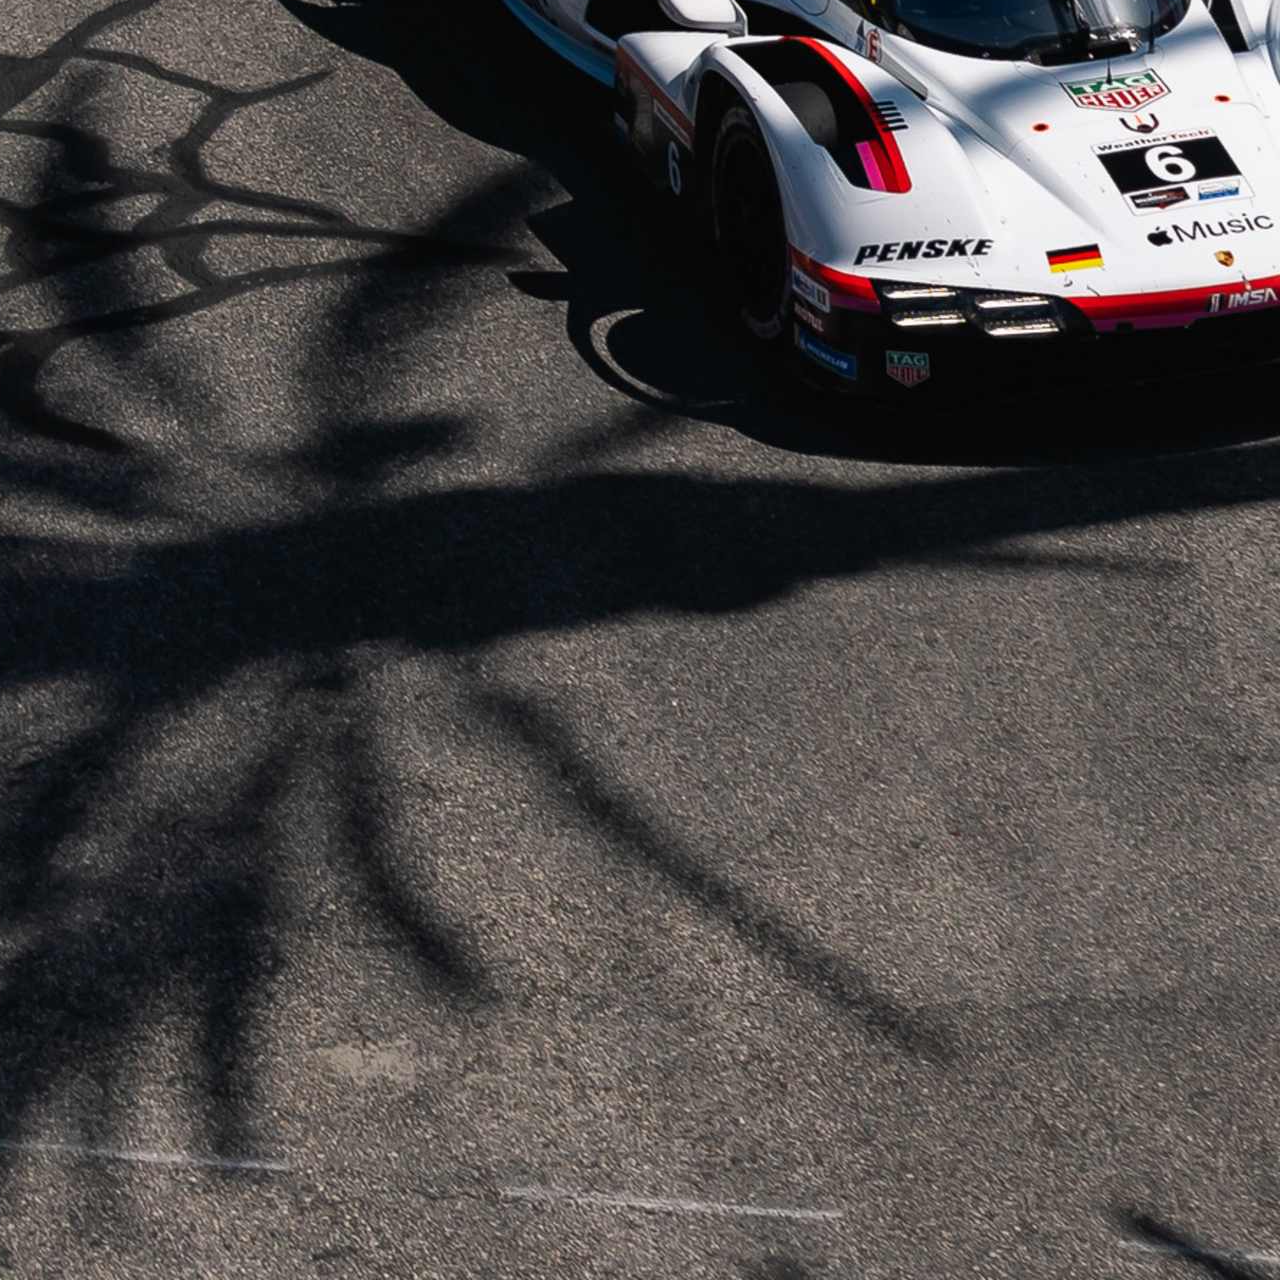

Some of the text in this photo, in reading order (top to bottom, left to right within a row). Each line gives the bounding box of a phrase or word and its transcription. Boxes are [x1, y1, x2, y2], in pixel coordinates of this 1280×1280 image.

[1070, 74, 1153, 95] TAG
[1076, 84, 1164, 109] HEUER
[1098, 129, 1211, 153] WeatherTech
[667, 140, 682, 197] 6
[1144, 145, 1197, 183] 6
[1173, 211, 1275, 243] Music
[853, 238, 995, 267] PENSKE
[1228, 287, 1279, 309] IMSA
[890, 353, 926, 367] TAG
[886, 367, 930, 385] HEUER
